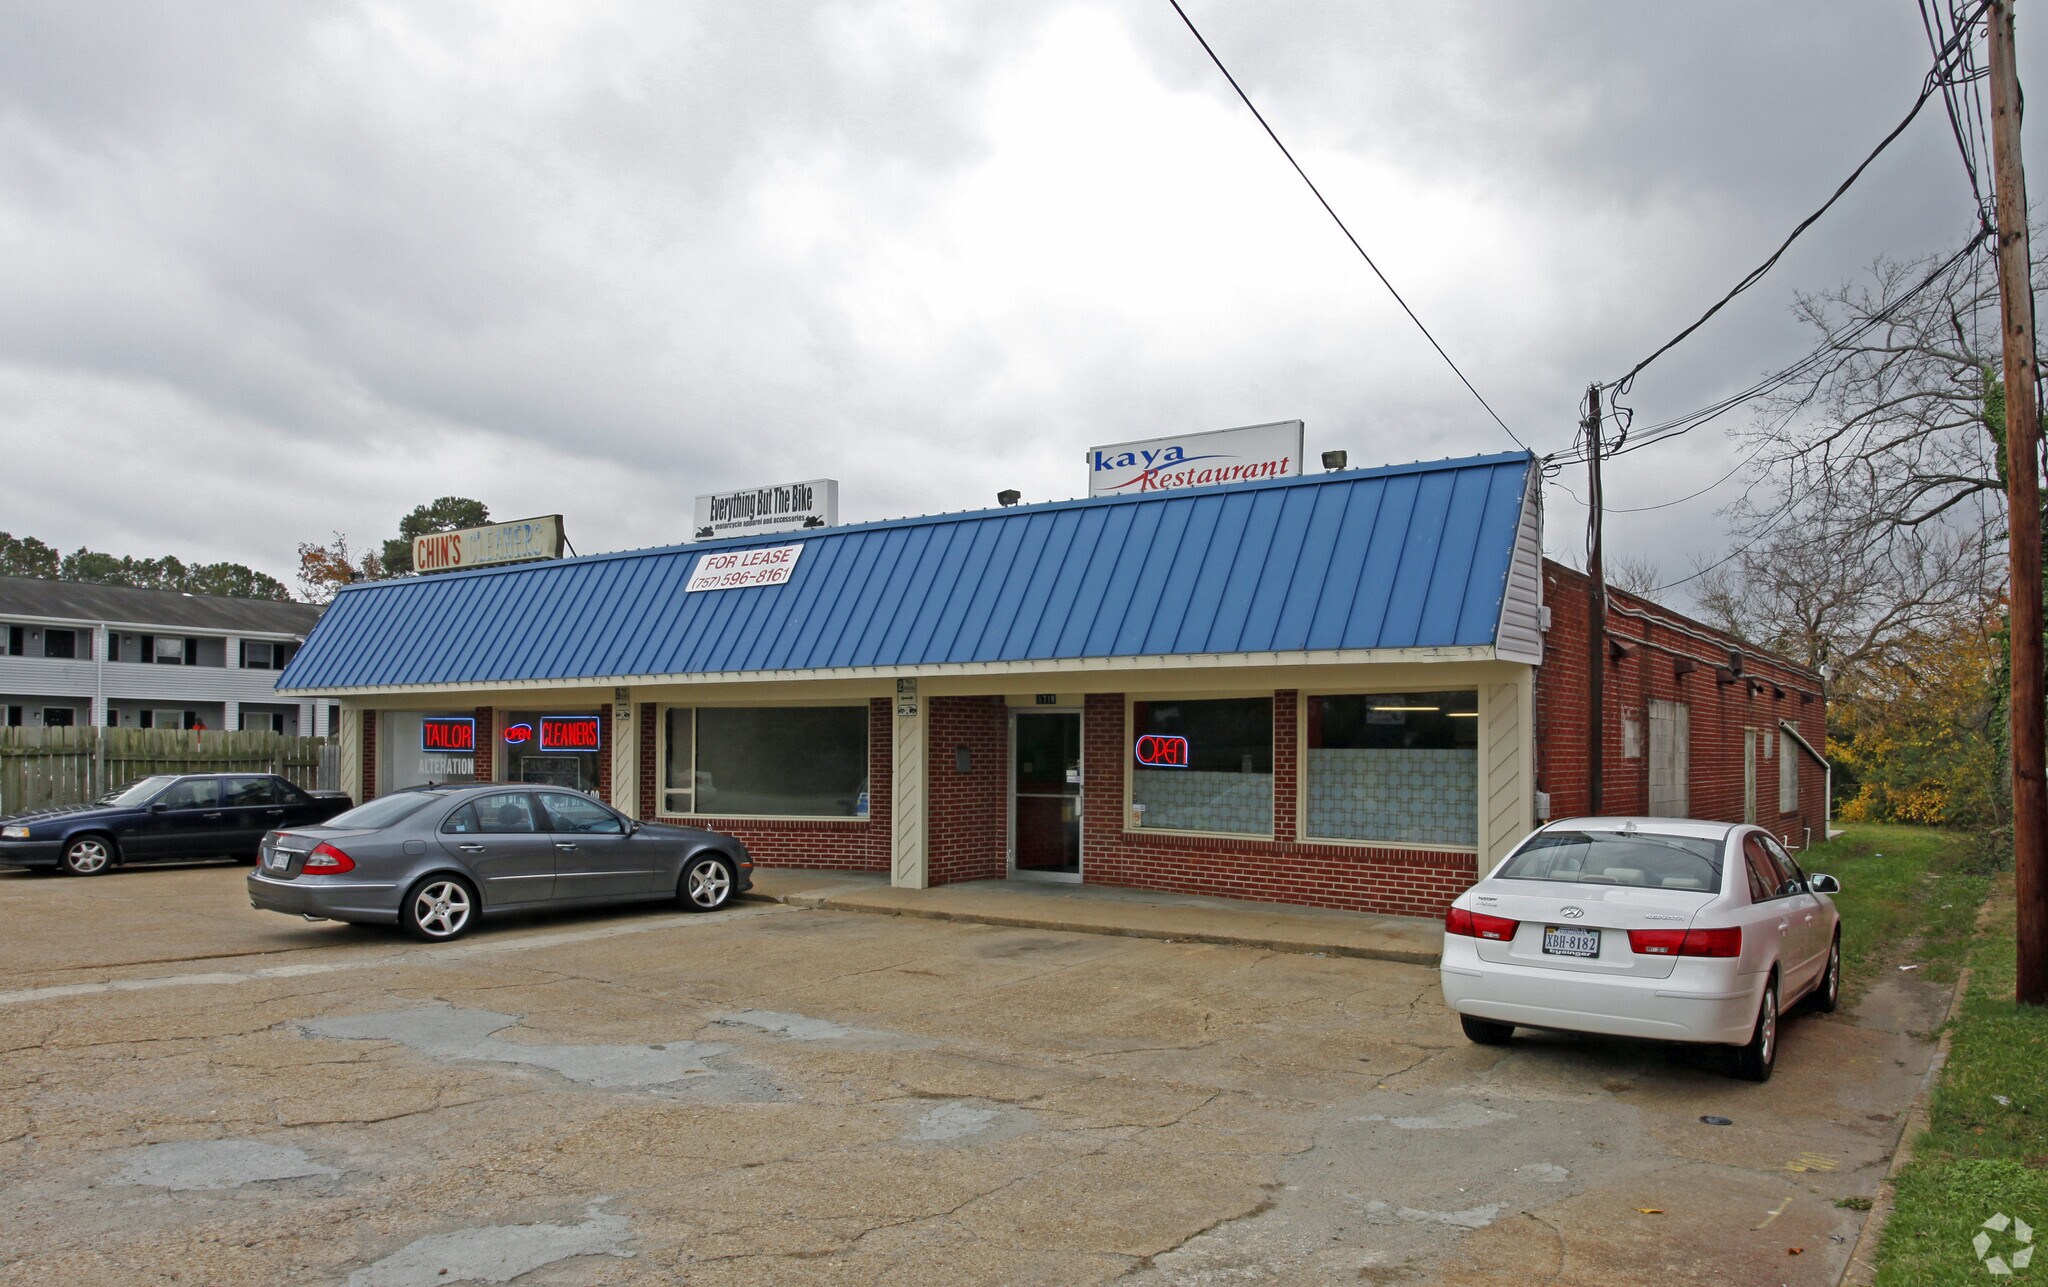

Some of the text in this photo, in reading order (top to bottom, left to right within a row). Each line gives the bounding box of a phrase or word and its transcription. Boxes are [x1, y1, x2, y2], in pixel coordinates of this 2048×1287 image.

[1094, 446, 1186, 472] kaya
[1140, 456, 1290, 491] Restaurant
[710, 483, 813, 523] Everything But The Bike
[714, 514, 805, 531] motorcycle apparel and accessories
[418, 534, 461, 570] CHIN'S
[705, 548, 793, 571] FOR LEASE
[691, 567, 790, 590] (757) 596-8161
[425, 723, 471, 748] TAILOR
[504, 727, 531, 740] OPEN
[542, 721, 596, 746] CLEANERS
[418, 758, 474, 775] ALTERATION
[1546, 934, 1596, 951] XBH-8182
